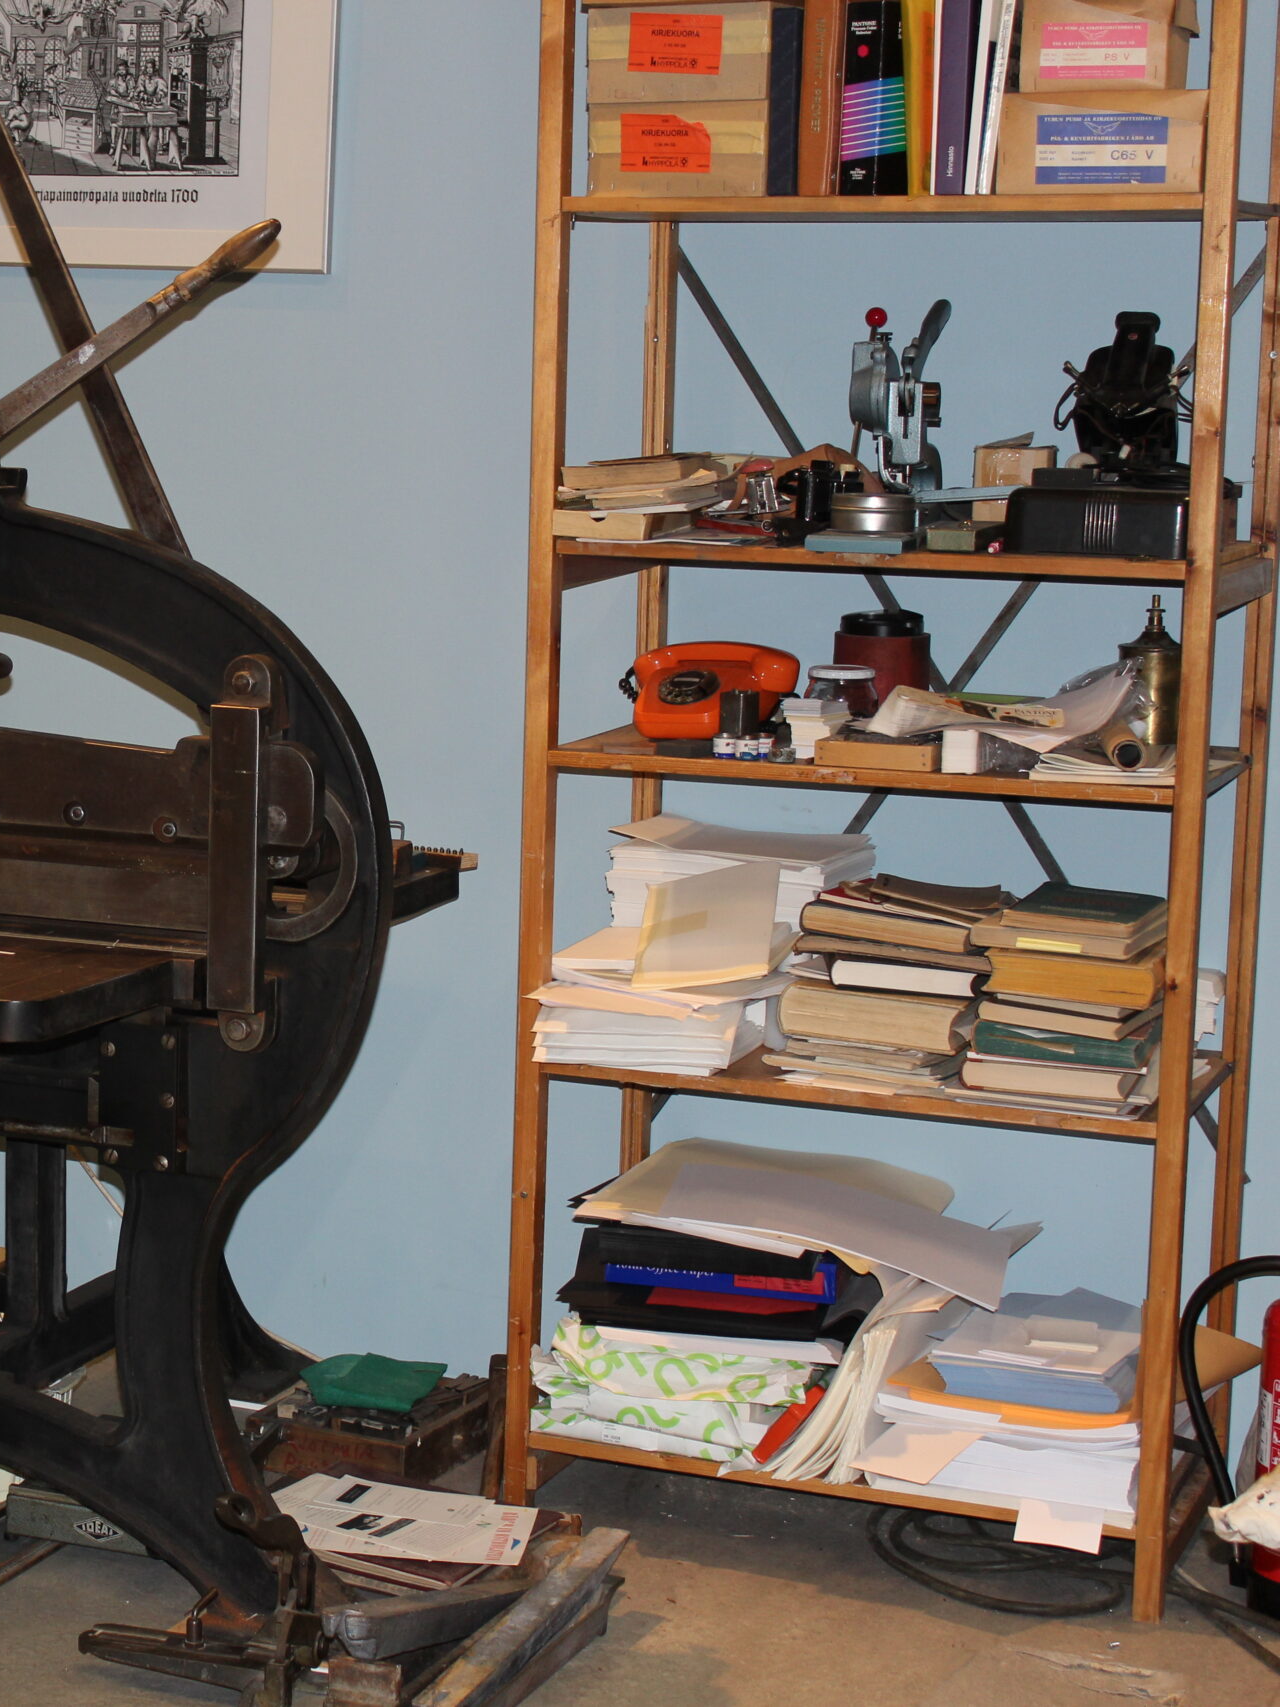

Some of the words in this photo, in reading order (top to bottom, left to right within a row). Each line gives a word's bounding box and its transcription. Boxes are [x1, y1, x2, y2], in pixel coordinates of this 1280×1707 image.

[651, 29, 700, 38] KIRJEKUORIA
[641, 129, 689, 137] KIRJEKUORIA
[946, 146, 954, 176] Hinnasto
[1110, 149, 1137, 161] C65
[1145, 149, 1154, 160] V
[171, 188, 199, 203] 1700
[1014, 708, 1057, 716] PANTONE
[81, 1520, 114, 1536] IDEAL
